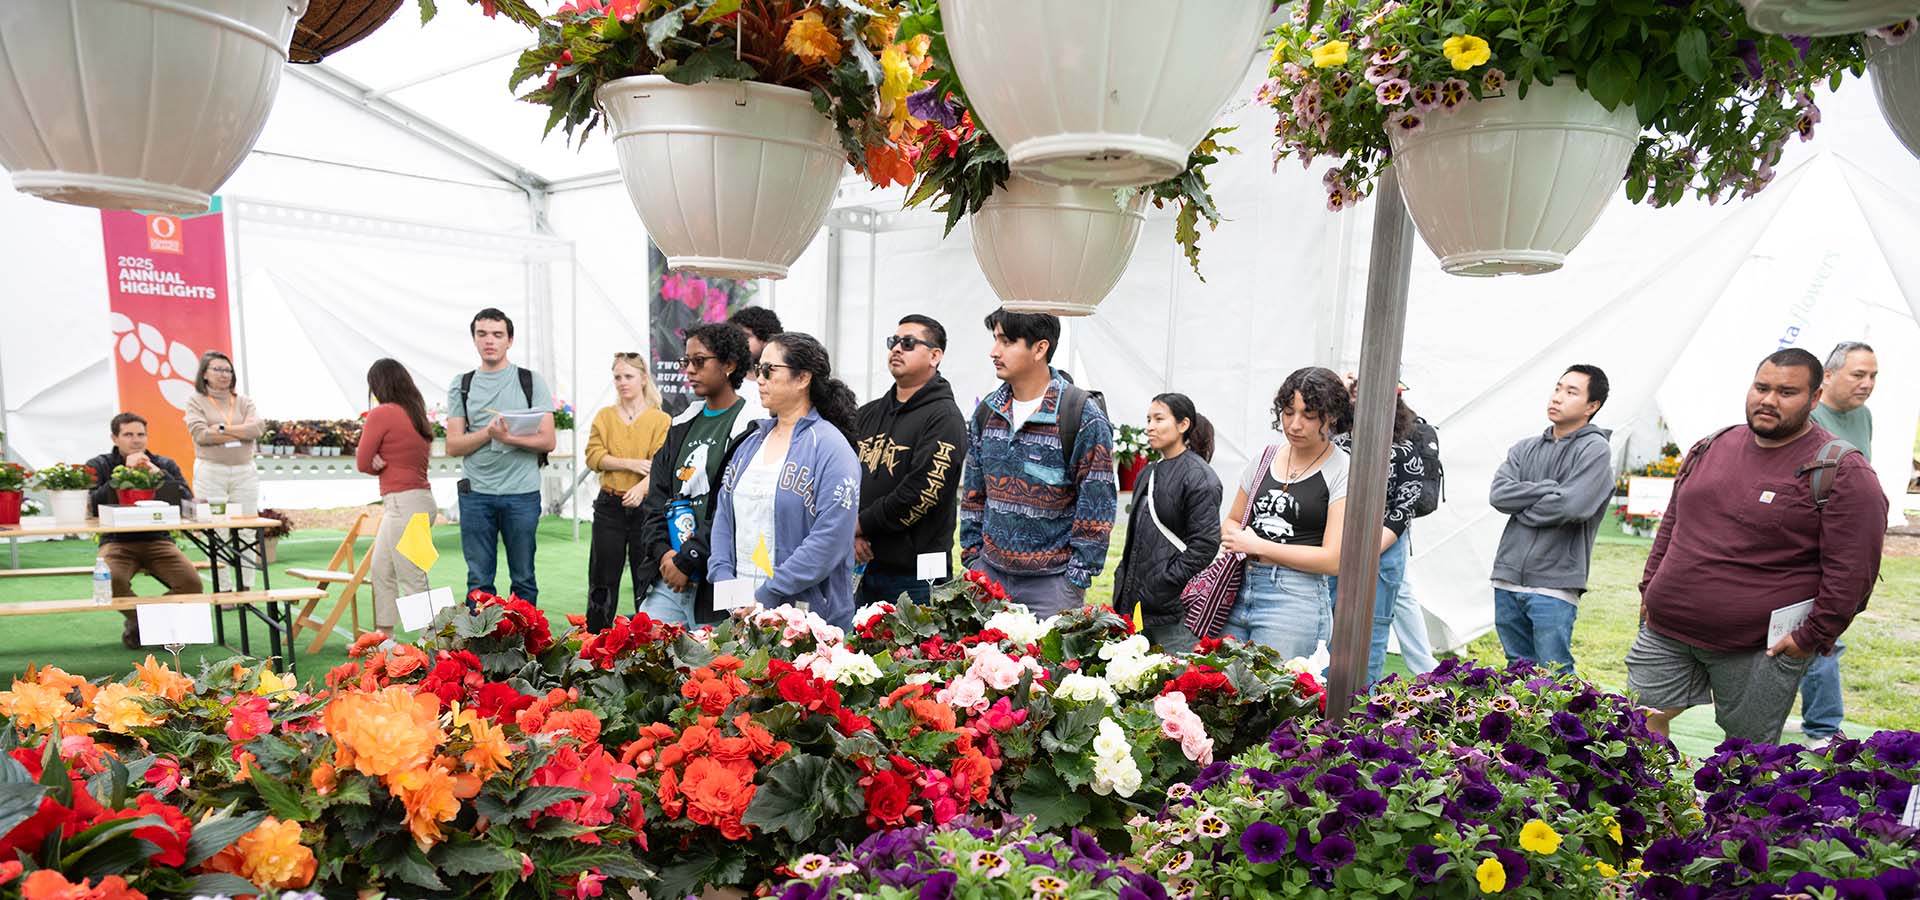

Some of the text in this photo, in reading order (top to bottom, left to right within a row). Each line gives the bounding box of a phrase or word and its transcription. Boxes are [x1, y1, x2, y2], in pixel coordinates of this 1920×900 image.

[117, 256, 154, 270] 2025
[119, 268, 186, 285] ANNUAL
[120, 281, 217, 299] HIGHLIGHTS
[656, 361, 681, 370] TWO
